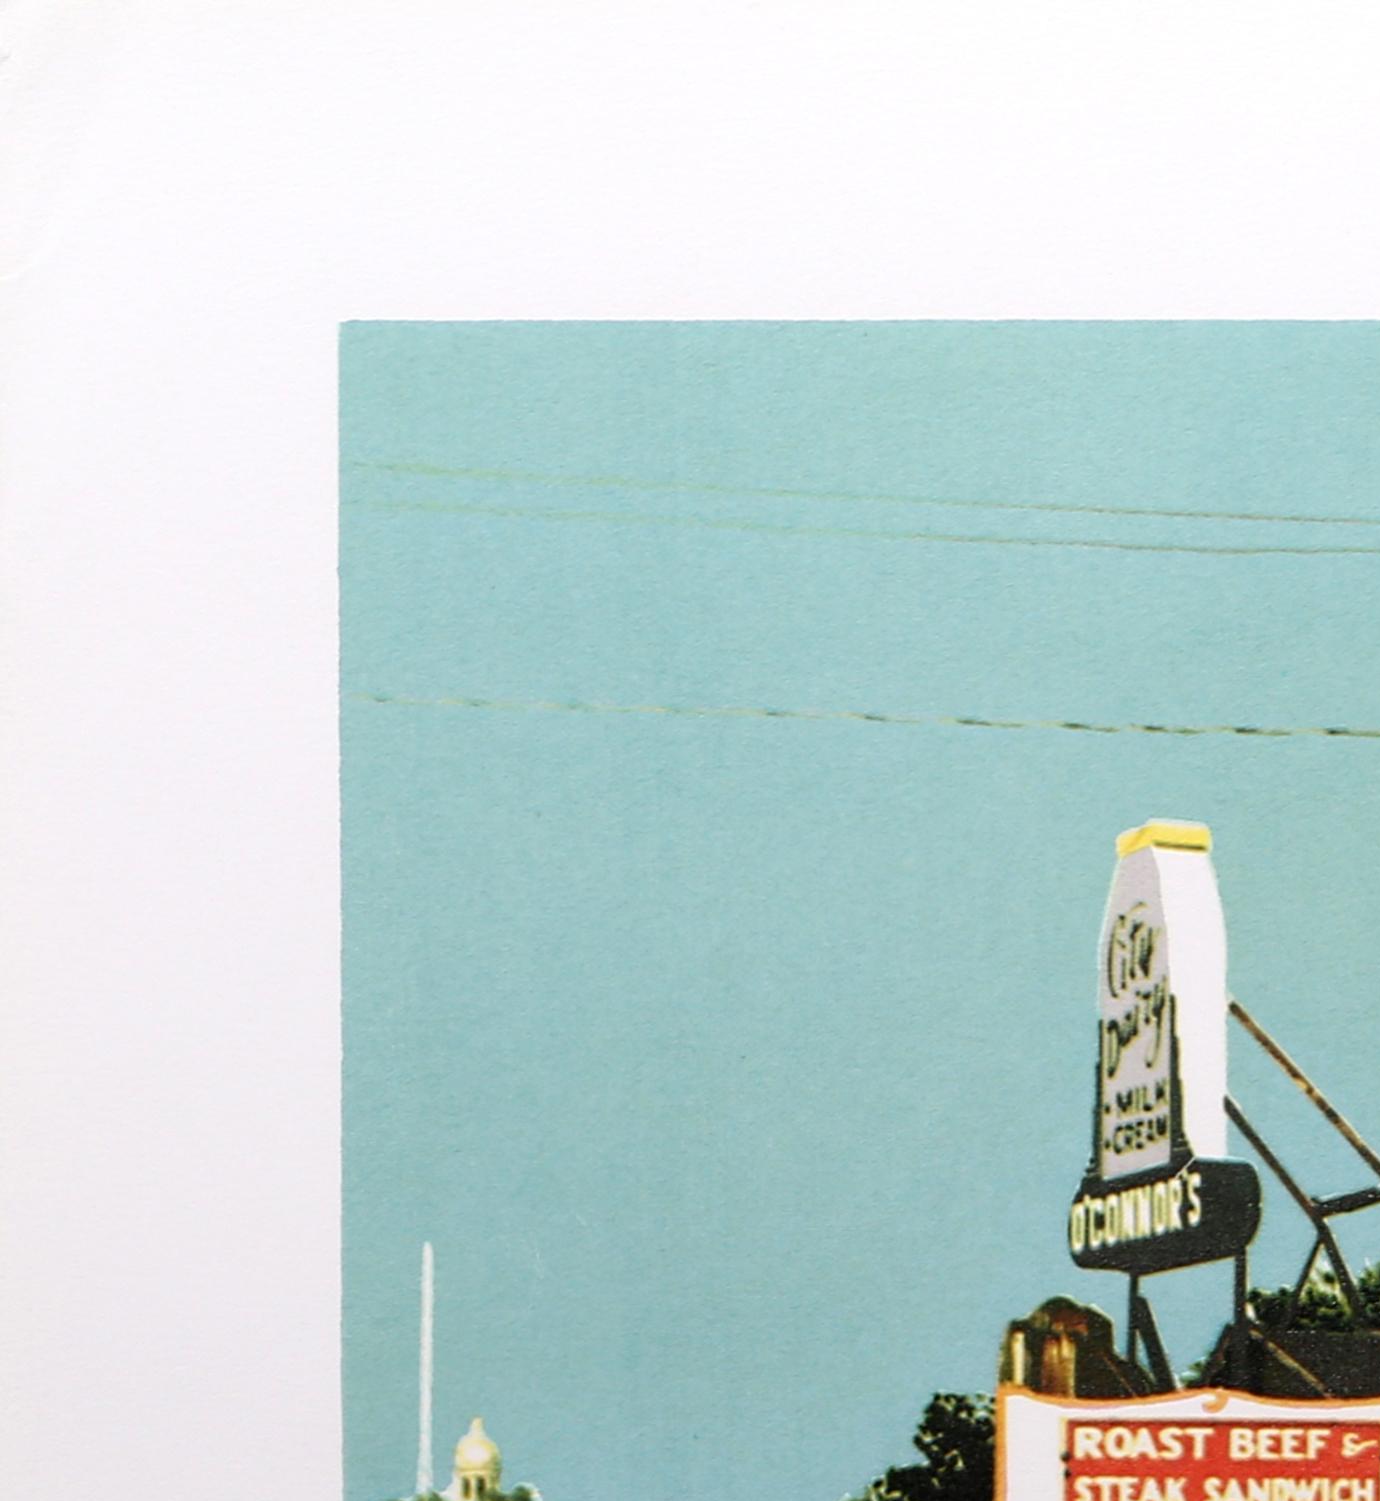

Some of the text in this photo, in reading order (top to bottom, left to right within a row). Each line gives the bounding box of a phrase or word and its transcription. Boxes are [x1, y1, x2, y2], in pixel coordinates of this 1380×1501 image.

[1105, 975, 1168, 1078] Dairy
[1113, 1114, 1169, 1155] CREAM
[1070, 1172, 1201, 1250] O'CONNOR'S
[1073, 1425, 1379, 1461] ROAST BEEF &
